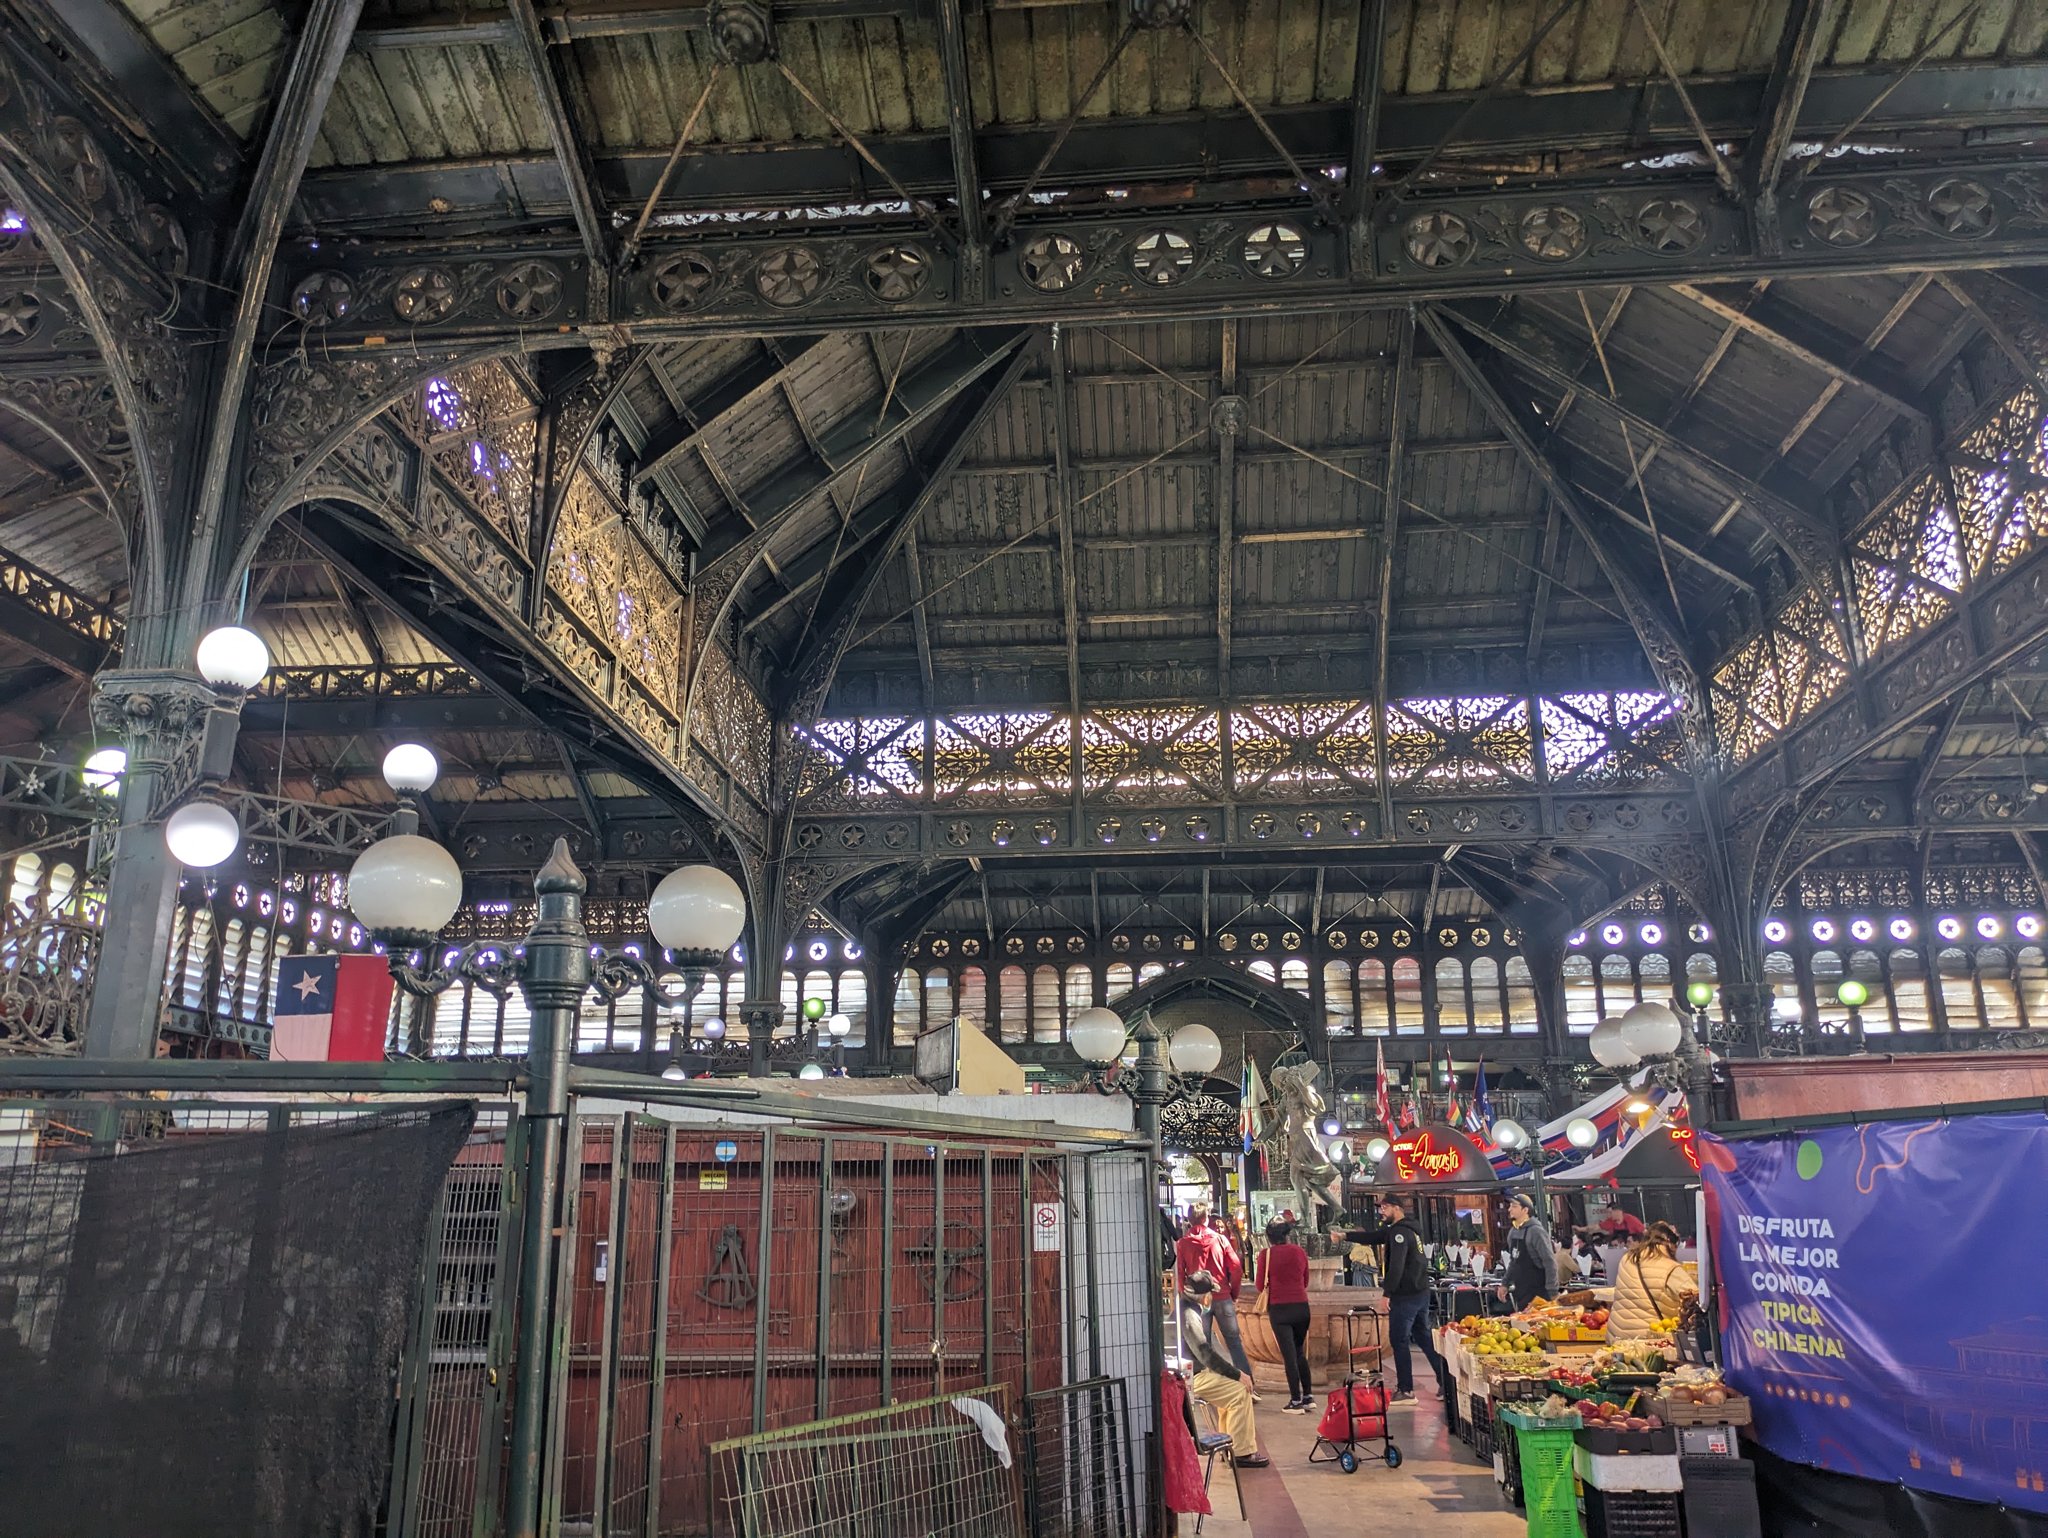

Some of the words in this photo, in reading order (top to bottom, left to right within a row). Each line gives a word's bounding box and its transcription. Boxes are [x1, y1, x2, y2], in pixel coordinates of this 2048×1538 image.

[1738, 1215, 1835, 1238] DISFRUTA
[1739, 1242, 1763, 1262] LA
[1764, 1244, 1840, 1269] MEJOR
[1751, 1271, 1831, 1298] COMIDA
[1761, 1301, 1824, 1327] TIPICA
[1752, 1328, 1845, 1359] CHILENA!
